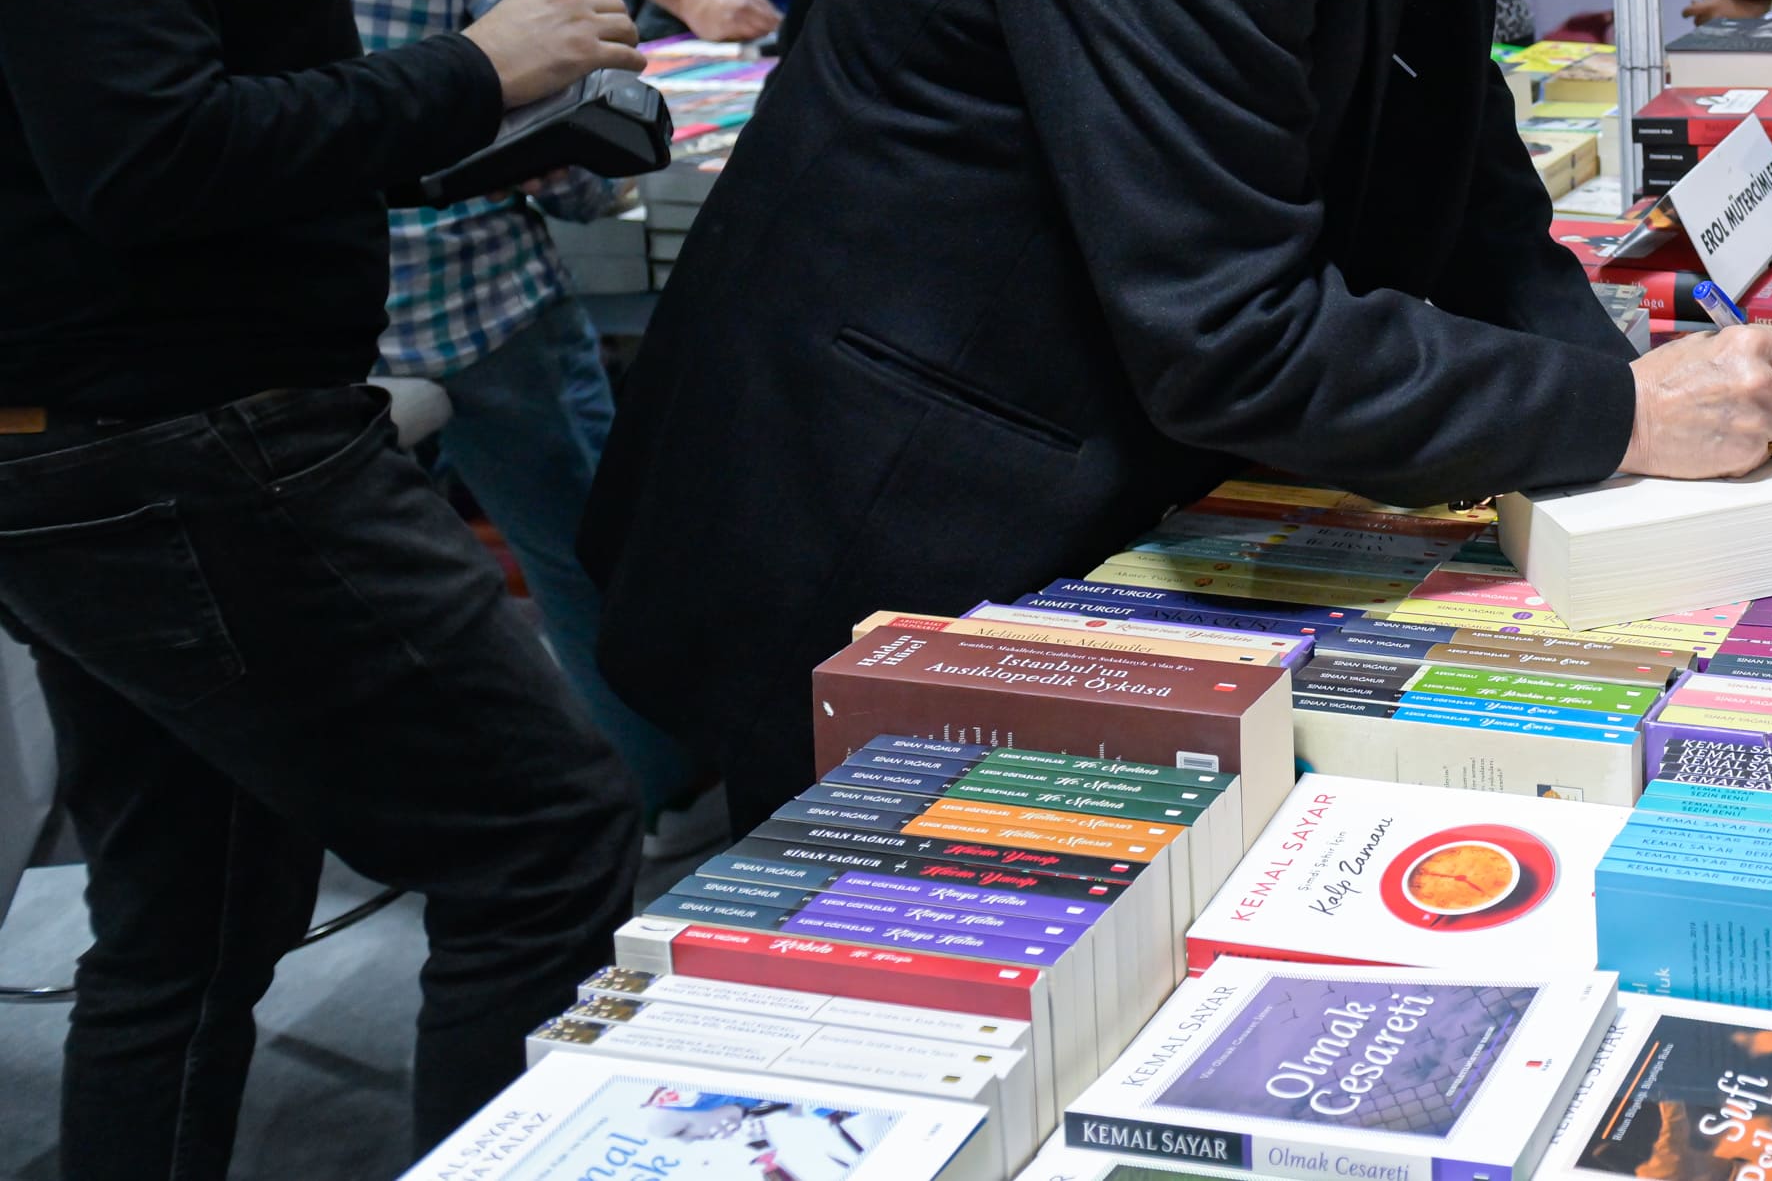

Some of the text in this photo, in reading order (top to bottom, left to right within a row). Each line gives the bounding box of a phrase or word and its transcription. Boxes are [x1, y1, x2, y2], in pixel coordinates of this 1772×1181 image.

[1700, 220, 1730, 255] EROL
[1028, 597, 1135, 616] AHMET TURGUT
[1062, 583, 1166, 601] AHMET TURGUT
[856, 635, 912, 668] Haldun
[882, 639, 927, 667] Hürel
[1347, 636, 1411, 650] SİNAN YAĞMUR
[923, 661, 1173, 699] Ansiklopedik Öyküsü
[997, 654, 1130, 679] İstanbul'un
[1298, 698, 1365, 712] SİNAN YAĞMUR
[892, 738, 961, 754] SİNAN YAĞMUR
[1681, 738, 1747, 753] KEMAL
[1677, 755, 1743, 770] KEMAL
[1673, 773, 1740, 788] KEMAL
[809, 828, 906, 848] SİNAN YAĞMUR
[1657, 815, 1699, 827] KEMAL
[1701, 819, 1747, 832] SAYAR
[782, 848, 881, 869] SİNAN YAĞMUR
[1231, 792, 1338, 923] KEMAL SAYAR
[1298, 829, 1349, 892] Şimdi Şehir İçin
[1308, 816, 1394, 917] Kalp Zamanı
[1121, 984, 1239, 1089] KEMAL SAYAR
[1265, 997, 1378, 1100] Olmak
[1308, 991, 1436, 1117] Cesareti
[1698, 1069, 1770, 1144] Sufi
[460, 1110, 526, 1158] SAYAR
[482, 1112, 552, 1162] YALAZ
[1082, 1121, 1411, 1181] KEMAL SAYAR Olmak Cesareti
